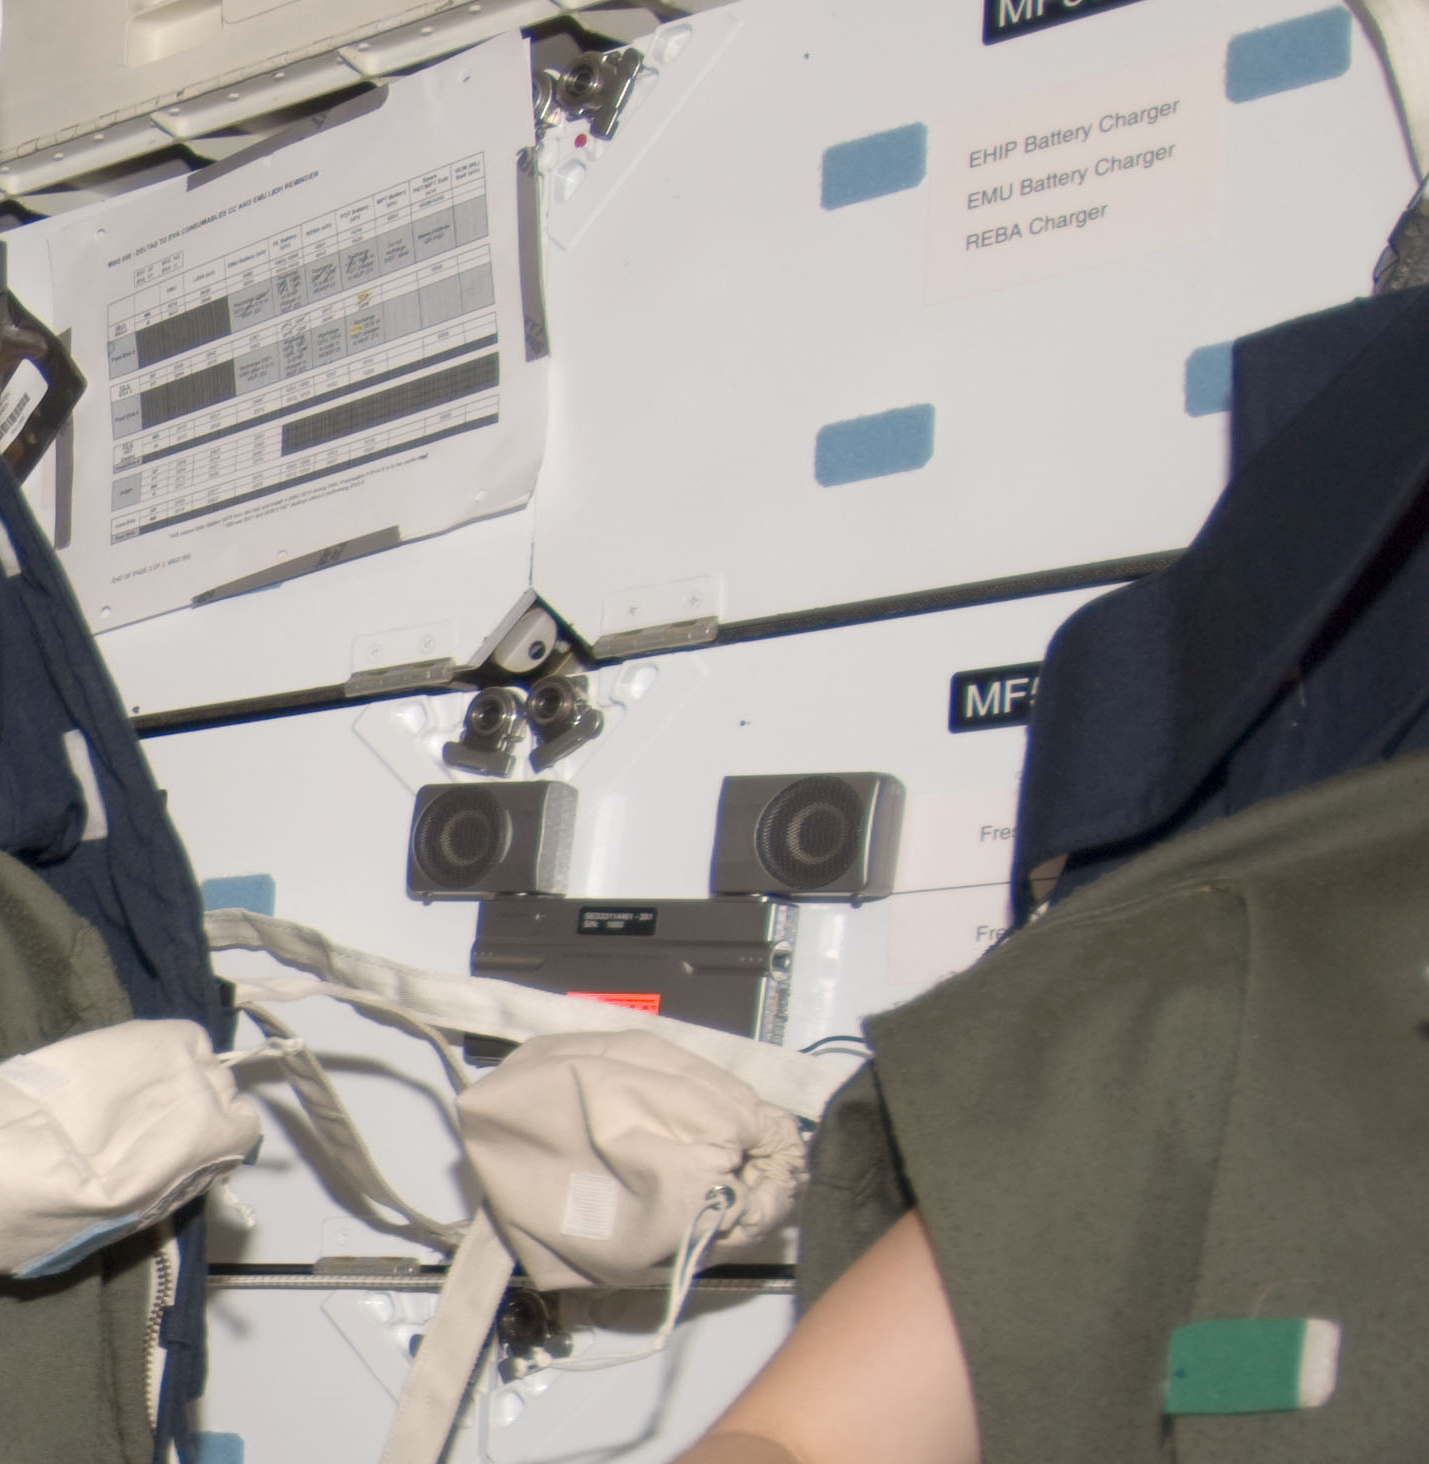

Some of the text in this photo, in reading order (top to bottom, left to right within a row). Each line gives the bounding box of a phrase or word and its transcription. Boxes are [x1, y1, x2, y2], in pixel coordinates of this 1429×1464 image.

[969, 100, 1180, 168] EHIP Battery Charger
[967, 143, 1176, 210] EMU Battery Charger
[965, 203, 1108, 251] REBA Charger
